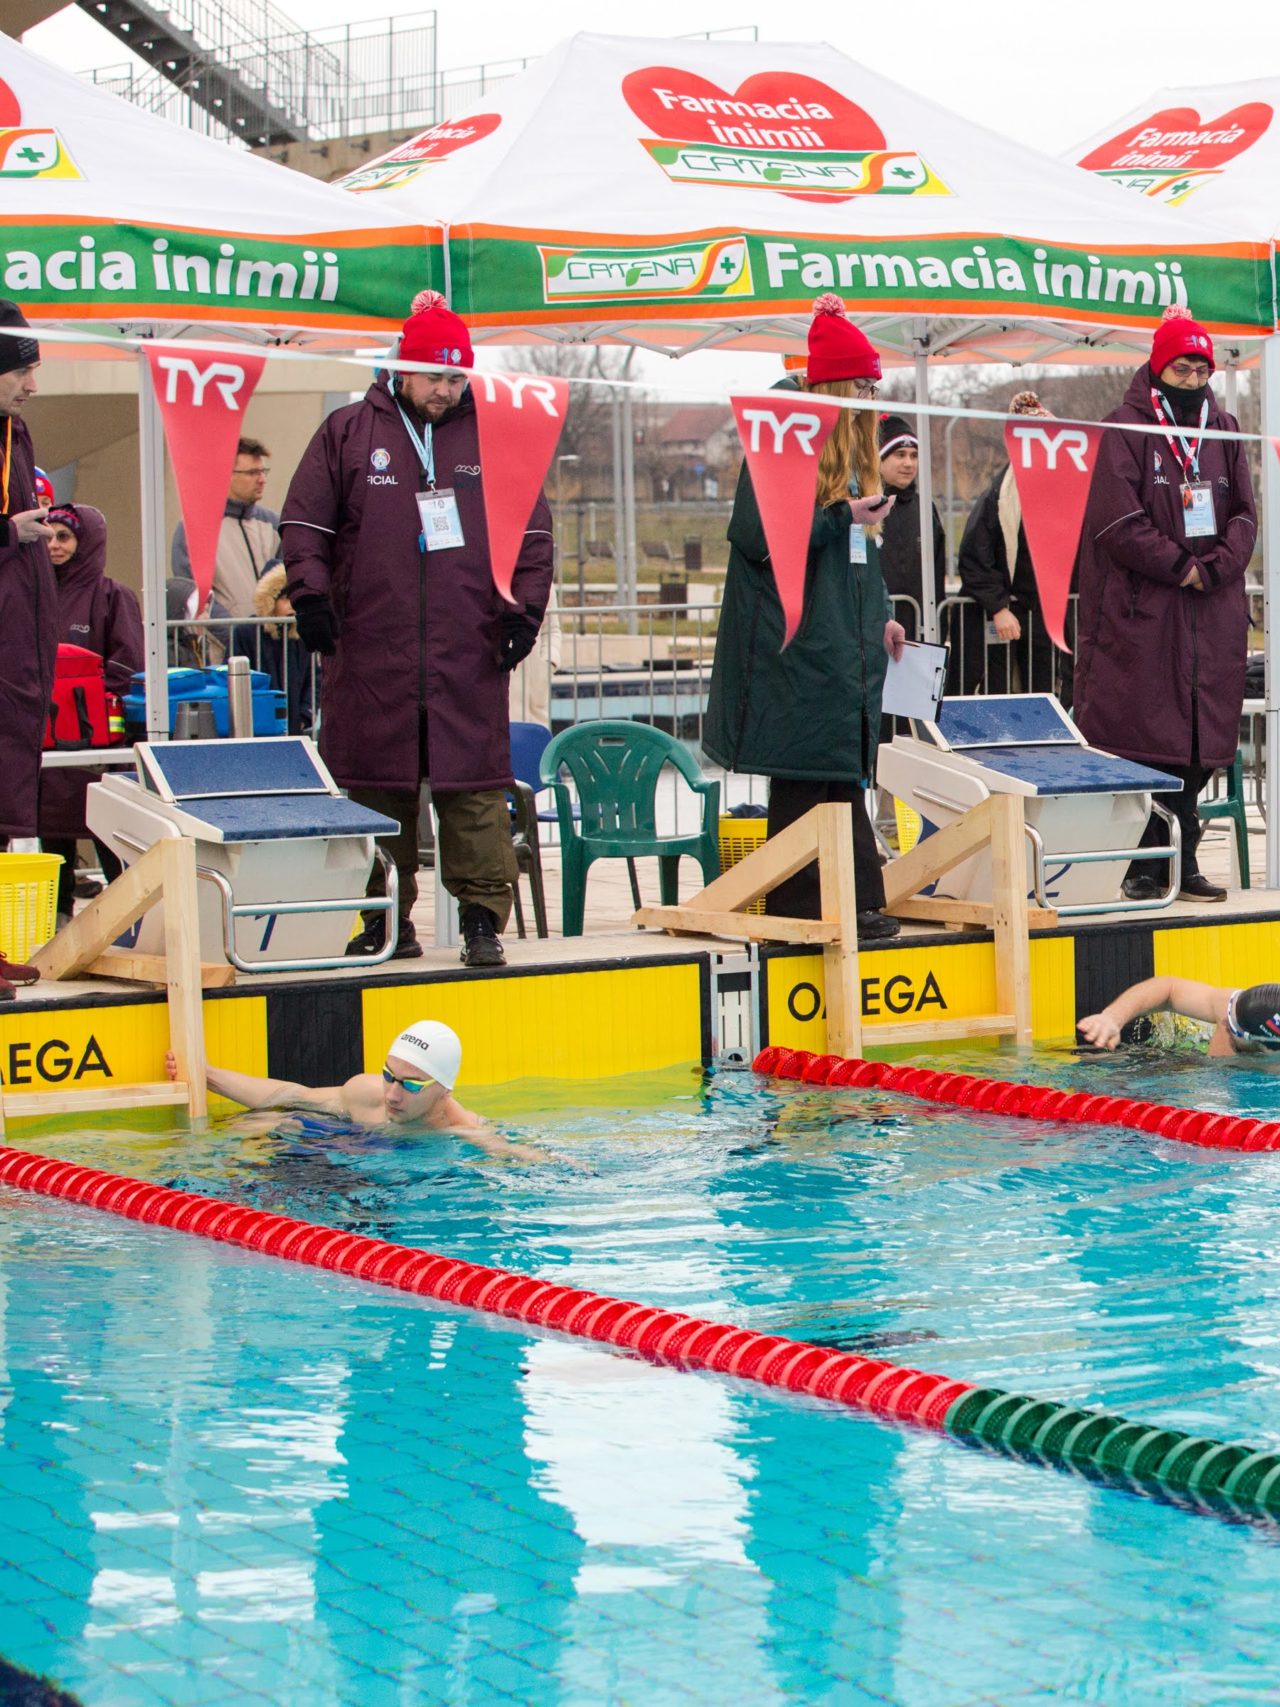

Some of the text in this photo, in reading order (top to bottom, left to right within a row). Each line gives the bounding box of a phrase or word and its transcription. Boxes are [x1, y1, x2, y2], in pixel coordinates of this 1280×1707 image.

[652, 87, 834, 120] Farmacia
[706, 118, 826, 147] inimii
[1125, 123, 1245, 148] Farmacia
[681, 154, 860, 182] CATENA
[1110, 149, 1200, 168] inimii
[152, 238, 340, 301] inimii
[566, 257, 696, 285] CATENA
[763, 242, 1188, 307] Farmacia inimii
[157, 356, 245, 410] TYR
[480, 373, 560, 418] TYR
[742, 409, 822, 456] TYR
[1012, 427, 1089, 472] TYR
[787, 969, 948, 1022] OEGA
[0, 1033, 113, 1086] EGA
[400, 1033, 430, 1051] arena
